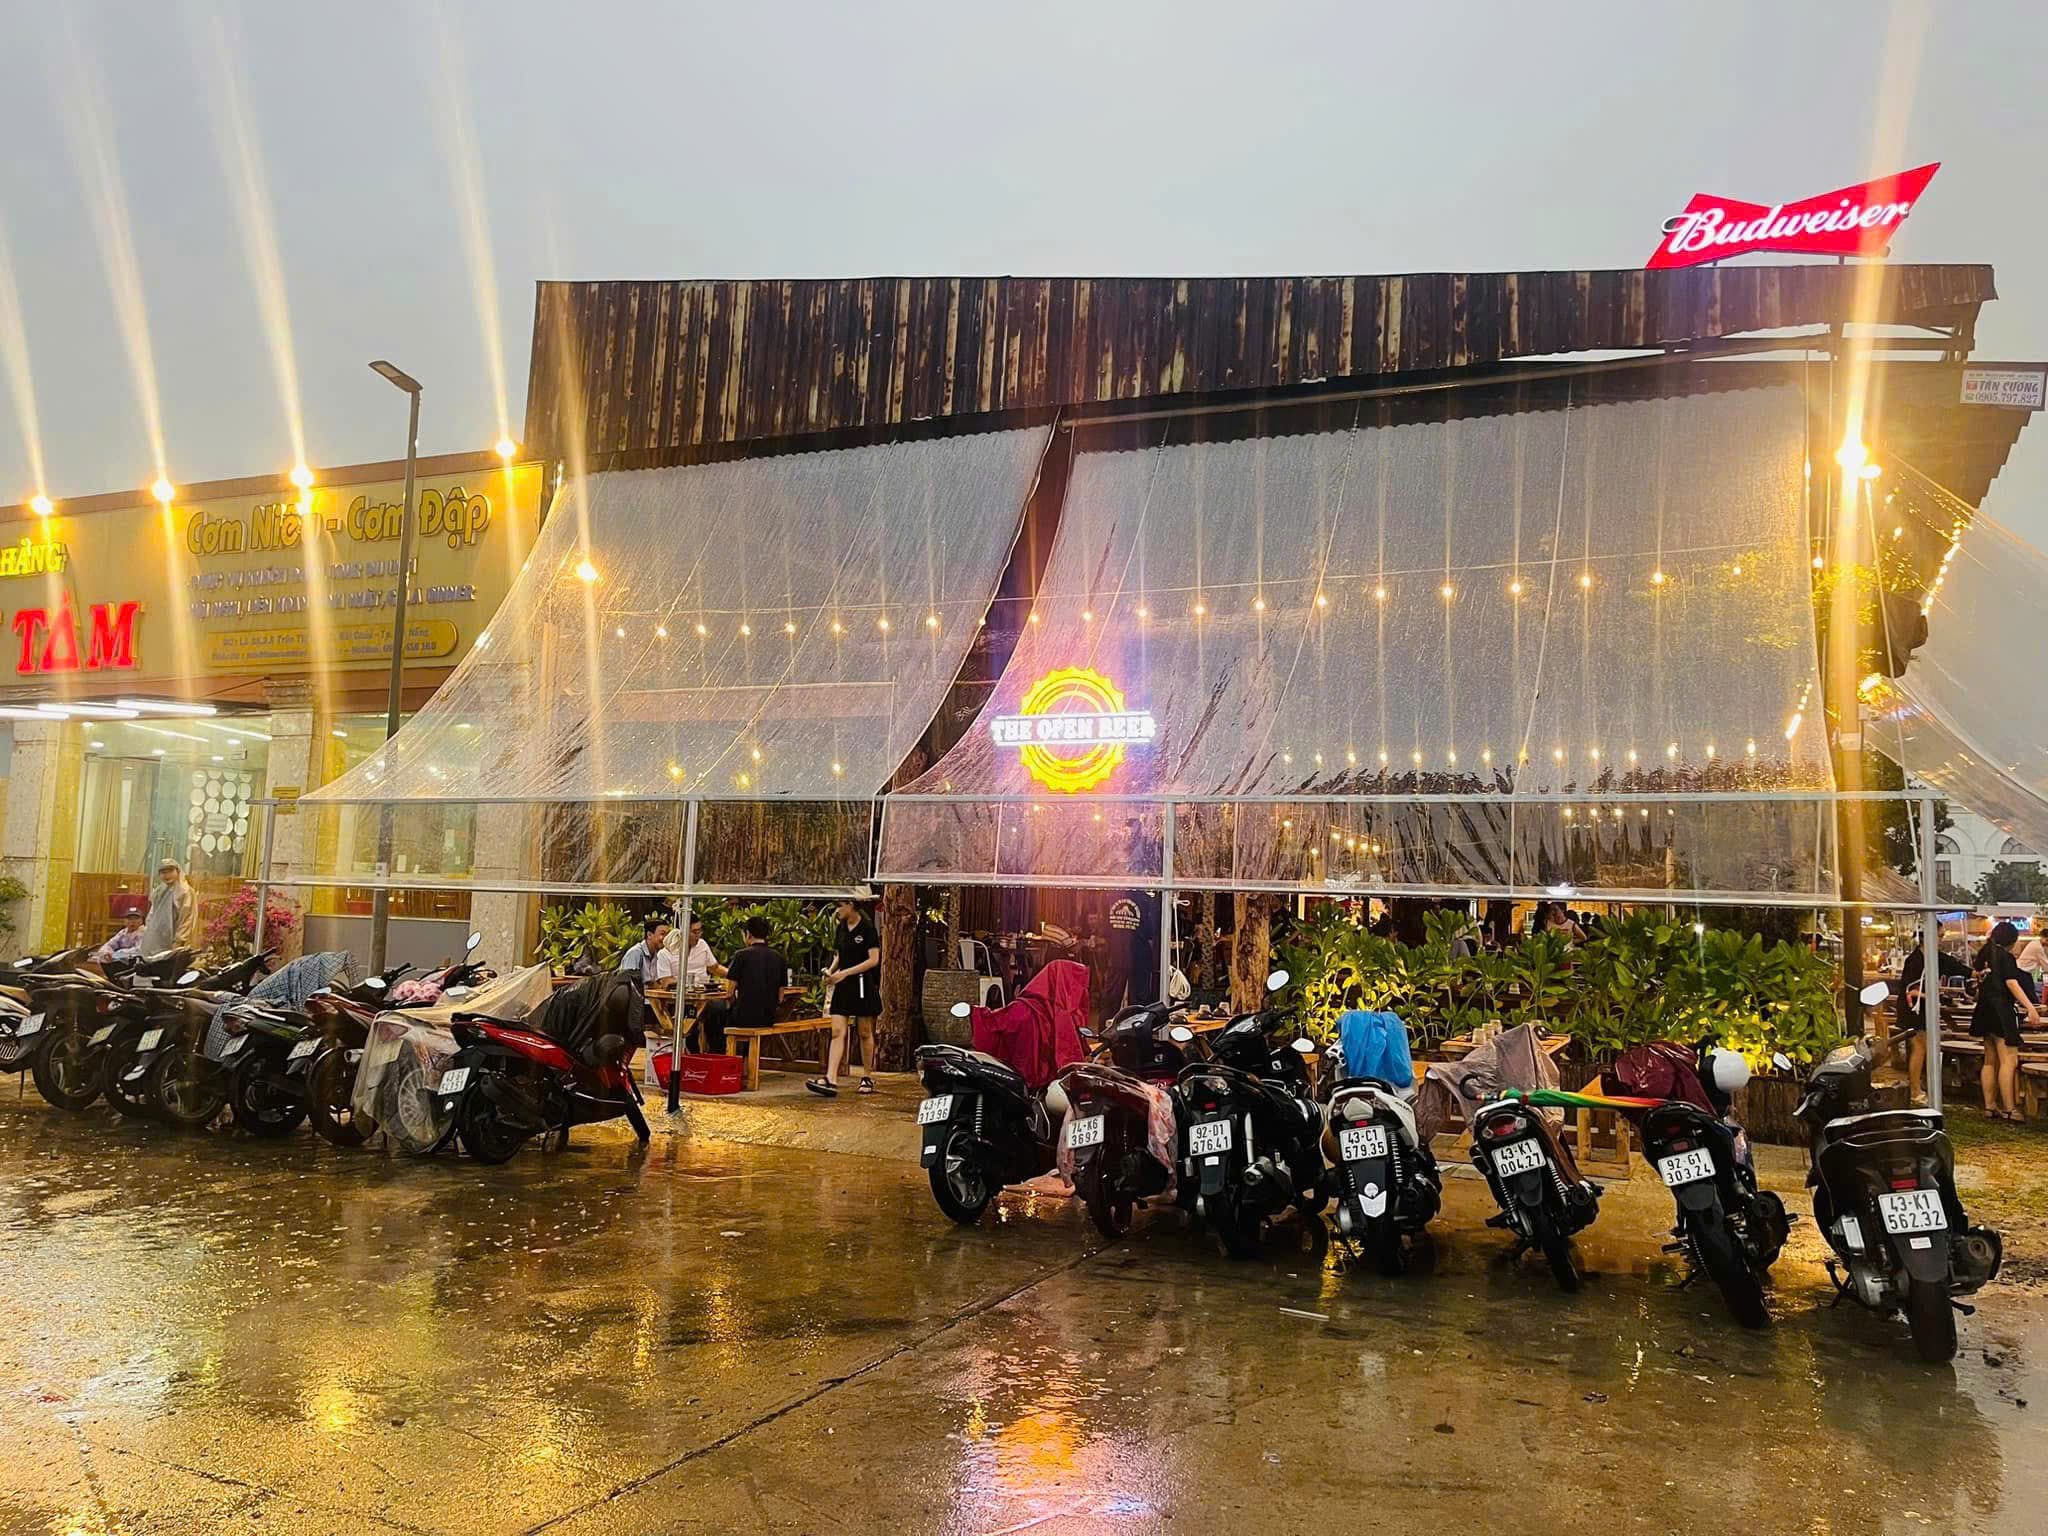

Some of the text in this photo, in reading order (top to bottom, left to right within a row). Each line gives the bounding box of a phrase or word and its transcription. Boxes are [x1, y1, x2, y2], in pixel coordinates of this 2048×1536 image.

[1660, 198, 1910, 255] Budweiser
[187, 511, 245, 555] Cơm
[418, 486, 490, 549] Đập
[990, 719, 1033, 742] THE
[1036, 717, 1094, 740] OPEN
[1071, 1130, 1098, 1146] 3692
[1191, 1136, 1229, 1154] 376.41
[1348, 1129, 1378, 1144] 43-C1
[1345, 1142, 1385, 1159] 579.35
[1500, 1141, 1533, 1161] 43-K1
[1501, 1152, 1541, 1175] 004.27
[1666, 1163, 1712, 1184] 303.24
[1890, 1194, 1931, 1212] 43-K1
[1887, 1210, 1944, 1230] 562.32
